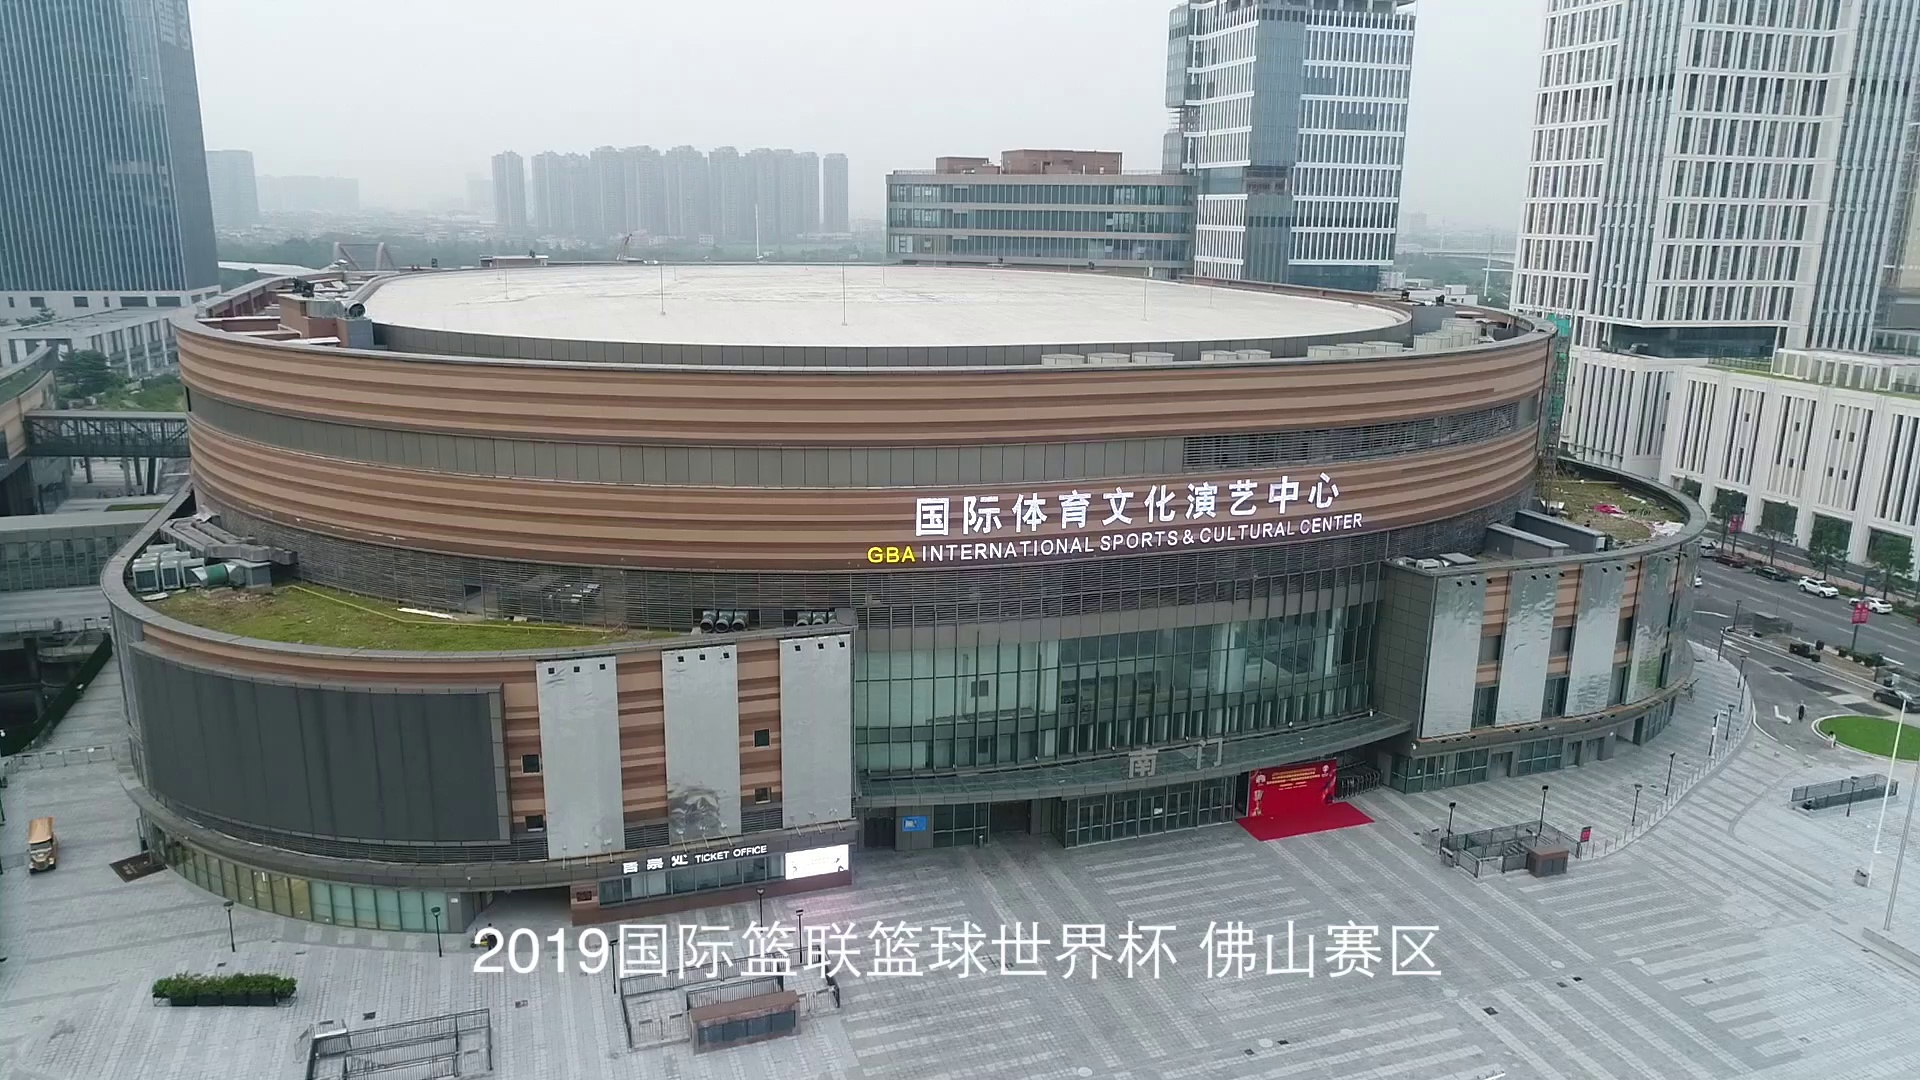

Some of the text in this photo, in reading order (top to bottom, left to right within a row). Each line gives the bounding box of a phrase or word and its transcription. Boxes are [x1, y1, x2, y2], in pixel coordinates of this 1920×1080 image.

[914, 472, 1340, 537] 国际体育文化演艺中心
[867, 512, 1363, 564] GBA INTERNATIONAL SPORTS & CULTURAL CENTER
[694, 850, 730, 864] TICKET
[732, 844, 768, 858] OFFICE
